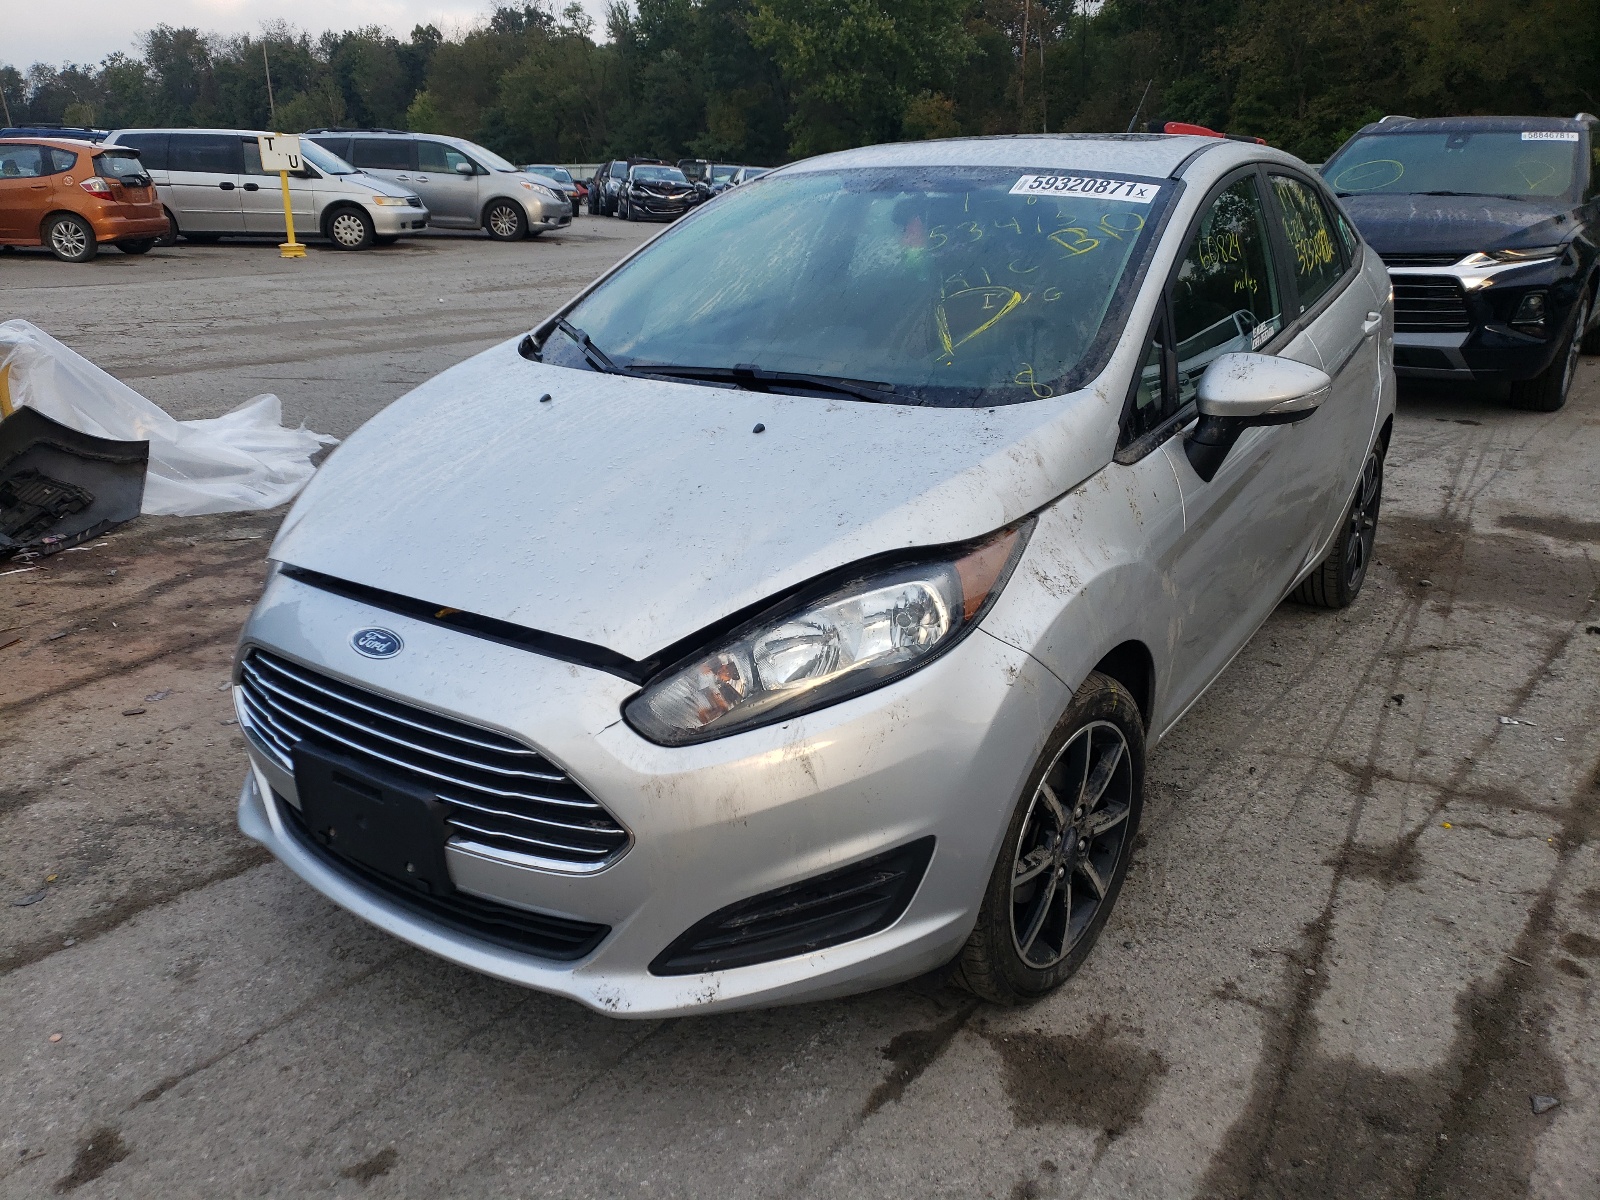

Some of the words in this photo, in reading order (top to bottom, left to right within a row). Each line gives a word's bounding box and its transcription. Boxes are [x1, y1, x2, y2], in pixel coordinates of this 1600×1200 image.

[263, 136, 275, 151] T
[288, 154, 299, 169] U
[358, 630, 392, 654] Ford
